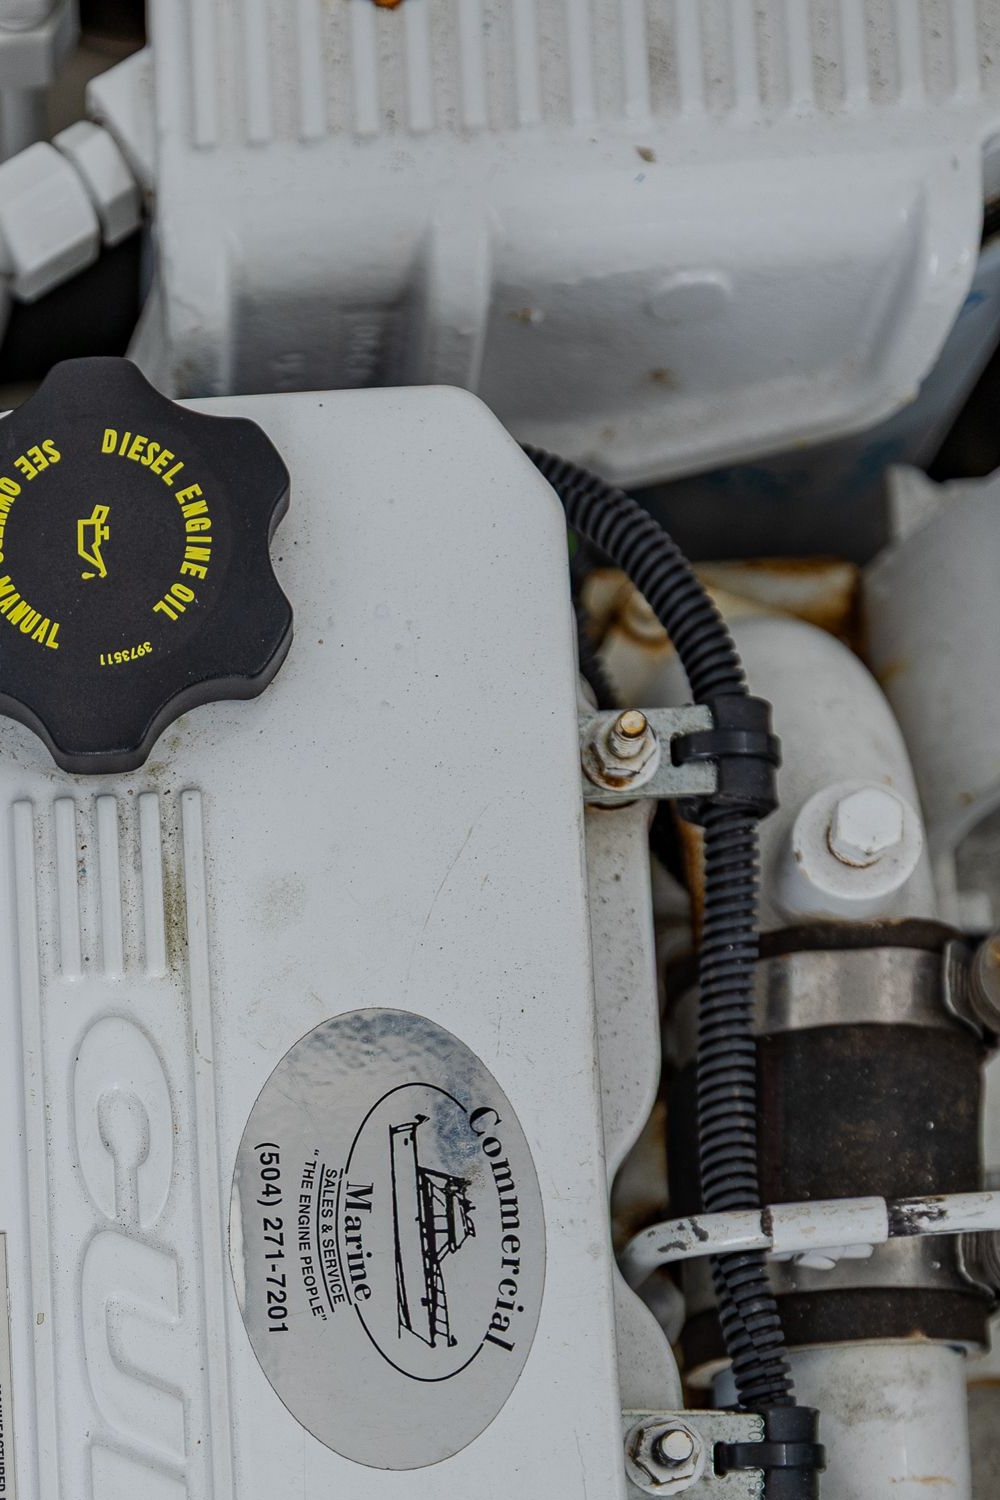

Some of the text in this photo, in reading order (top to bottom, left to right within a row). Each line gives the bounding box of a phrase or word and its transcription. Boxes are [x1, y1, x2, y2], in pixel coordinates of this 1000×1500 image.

[14, 438, 61, 480] SEE
[101, 428, 212, 621] DIESEL ENGINE OIL
[99, 641, 153, 666] 3973511
[254, 1142, 290, 1333] (504) 271-7201
[298, 1194, 312, 1251] ENGINE
[321, 1168, 346, 1304] SALES & SERVICE
[344, 1180, 375, 1302] Marine
[468, 1105, 525, 1352] Commercial
